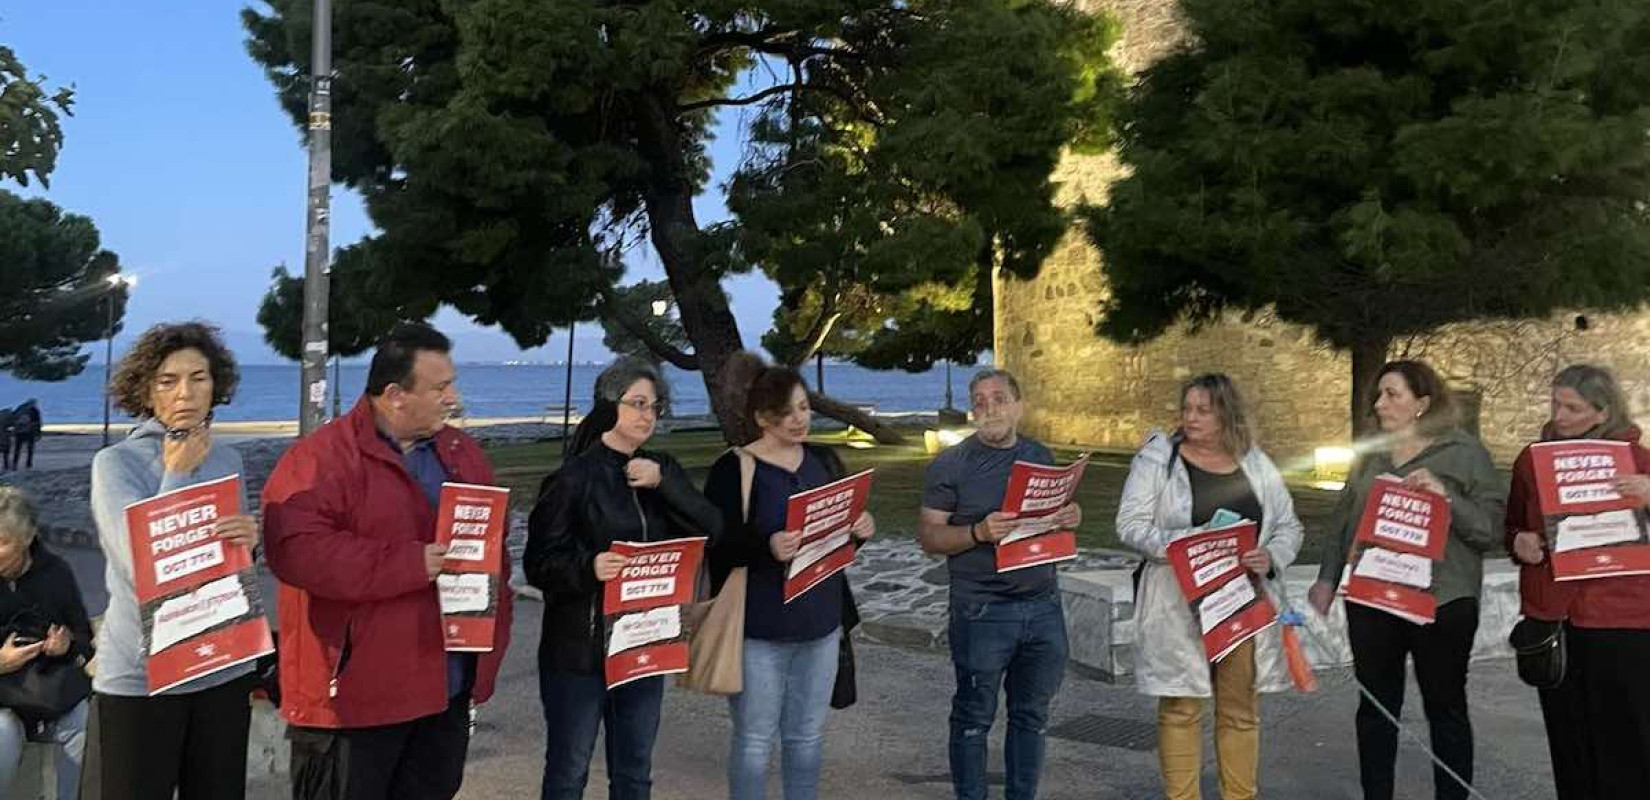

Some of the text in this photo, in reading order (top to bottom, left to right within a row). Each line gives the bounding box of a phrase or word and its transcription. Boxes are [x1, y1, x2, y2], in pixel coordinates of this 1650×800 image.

[1554, 455, 1615, 470] NEVER
[1028, 474, 1075, 488] NEVER
[1554, 468, 1617, 483] FORGET
[806, 488, 855, 514] NEVER
[1381, 493, 1432, 515] NEVER
[1565, 489, 1589, 499] OCT
[148, 504, 218, 538] NEVER
[1378, 507, 1431, 527] FORGET
[151, 524, 219, 556] FORGET
[1380, 525, 1423, 542] OCT 7TH
[1187, 537, 1238, 557] NEVER
[163, 550, 216, 576] OCT 7TH
[1189, 547, 1238, 570] FORGET
[621, 563, 680, 578] FORGET
[626, 581, 670, 596] OCT 7TH
